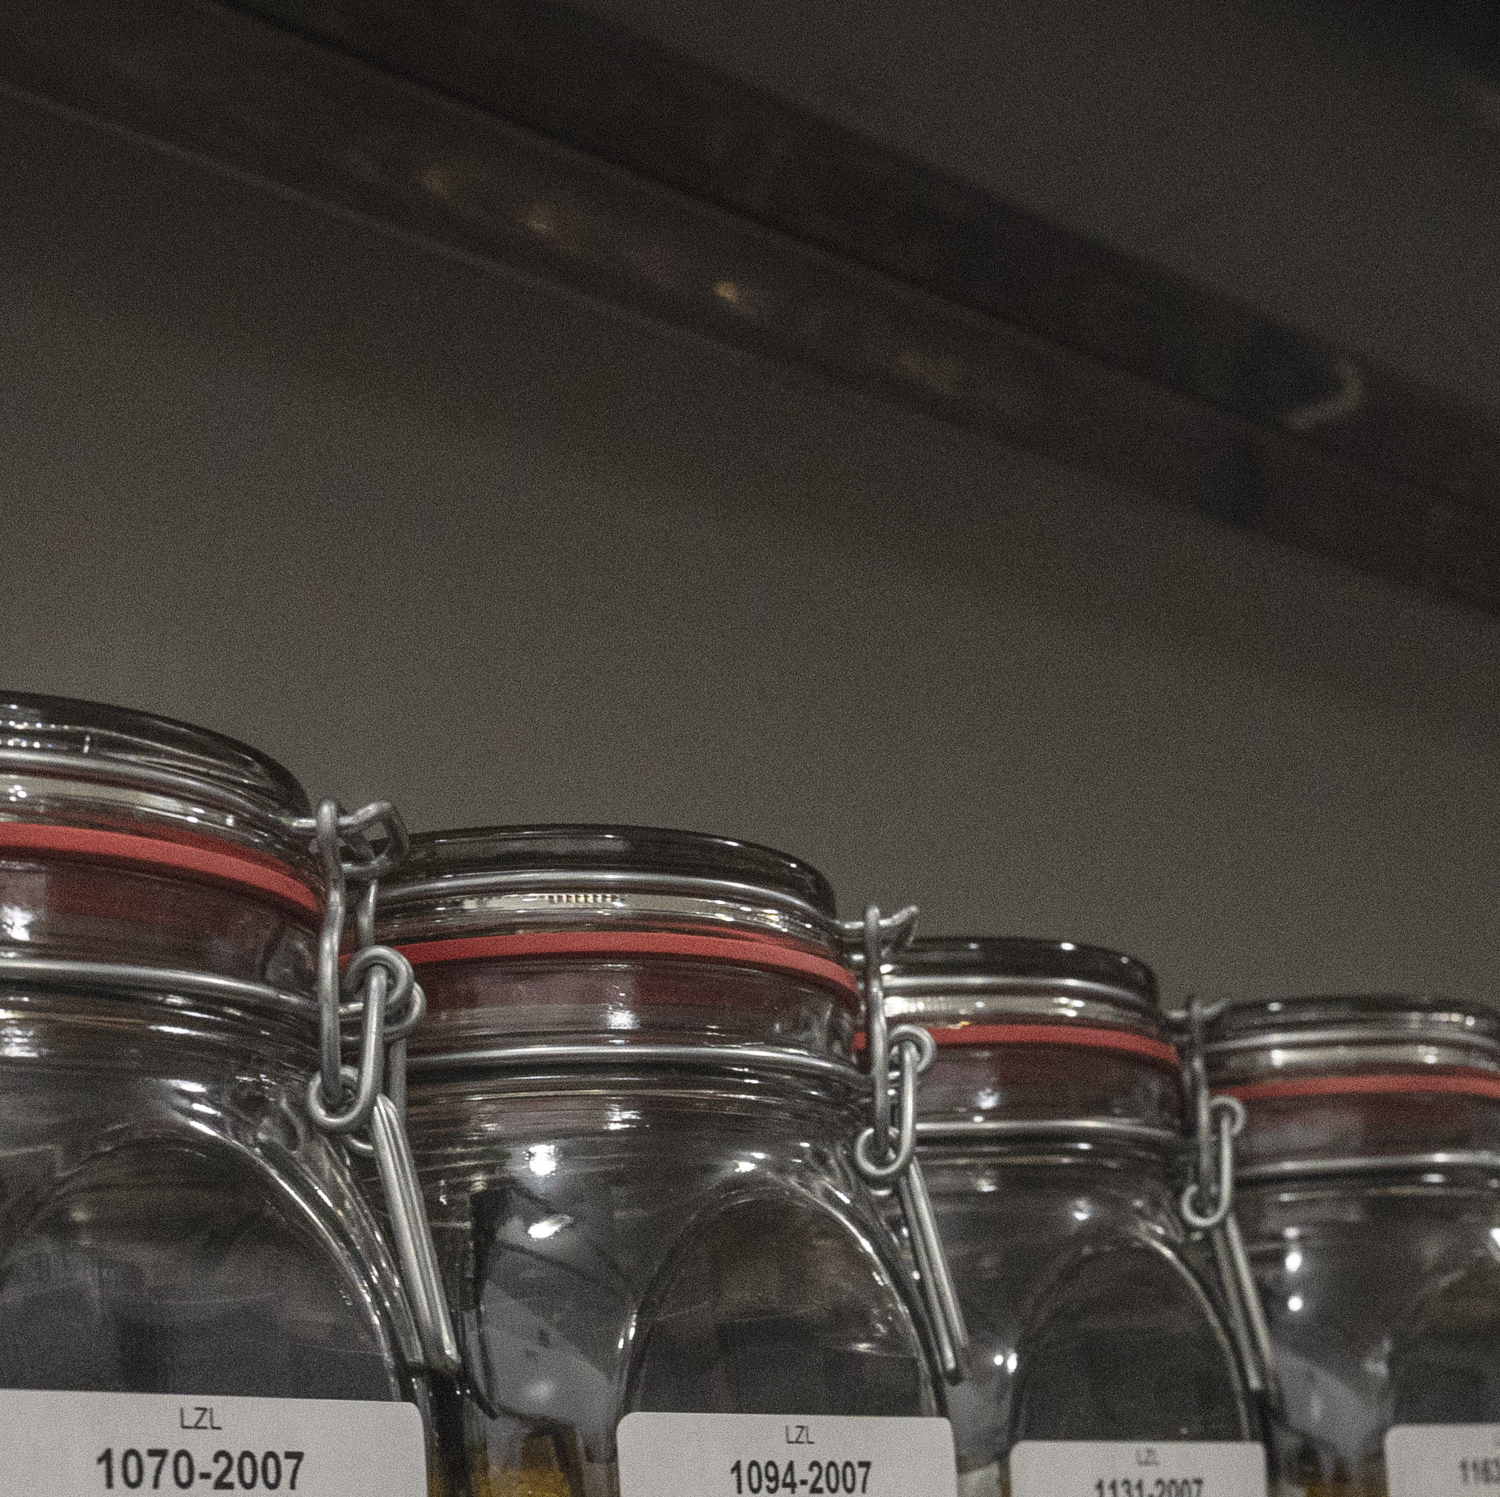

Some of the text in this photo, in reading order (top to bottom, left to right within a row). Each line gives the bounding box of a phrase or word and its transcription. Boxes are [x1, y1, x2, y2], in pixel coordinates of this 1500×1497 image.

[179, 1407, 222, 1430] LZL
[785, 1425, 815, 1444] LZL
[97, 1448, 305, 1490] 1070-2007
[731, 1460, 872, 1494] 1094-2007
